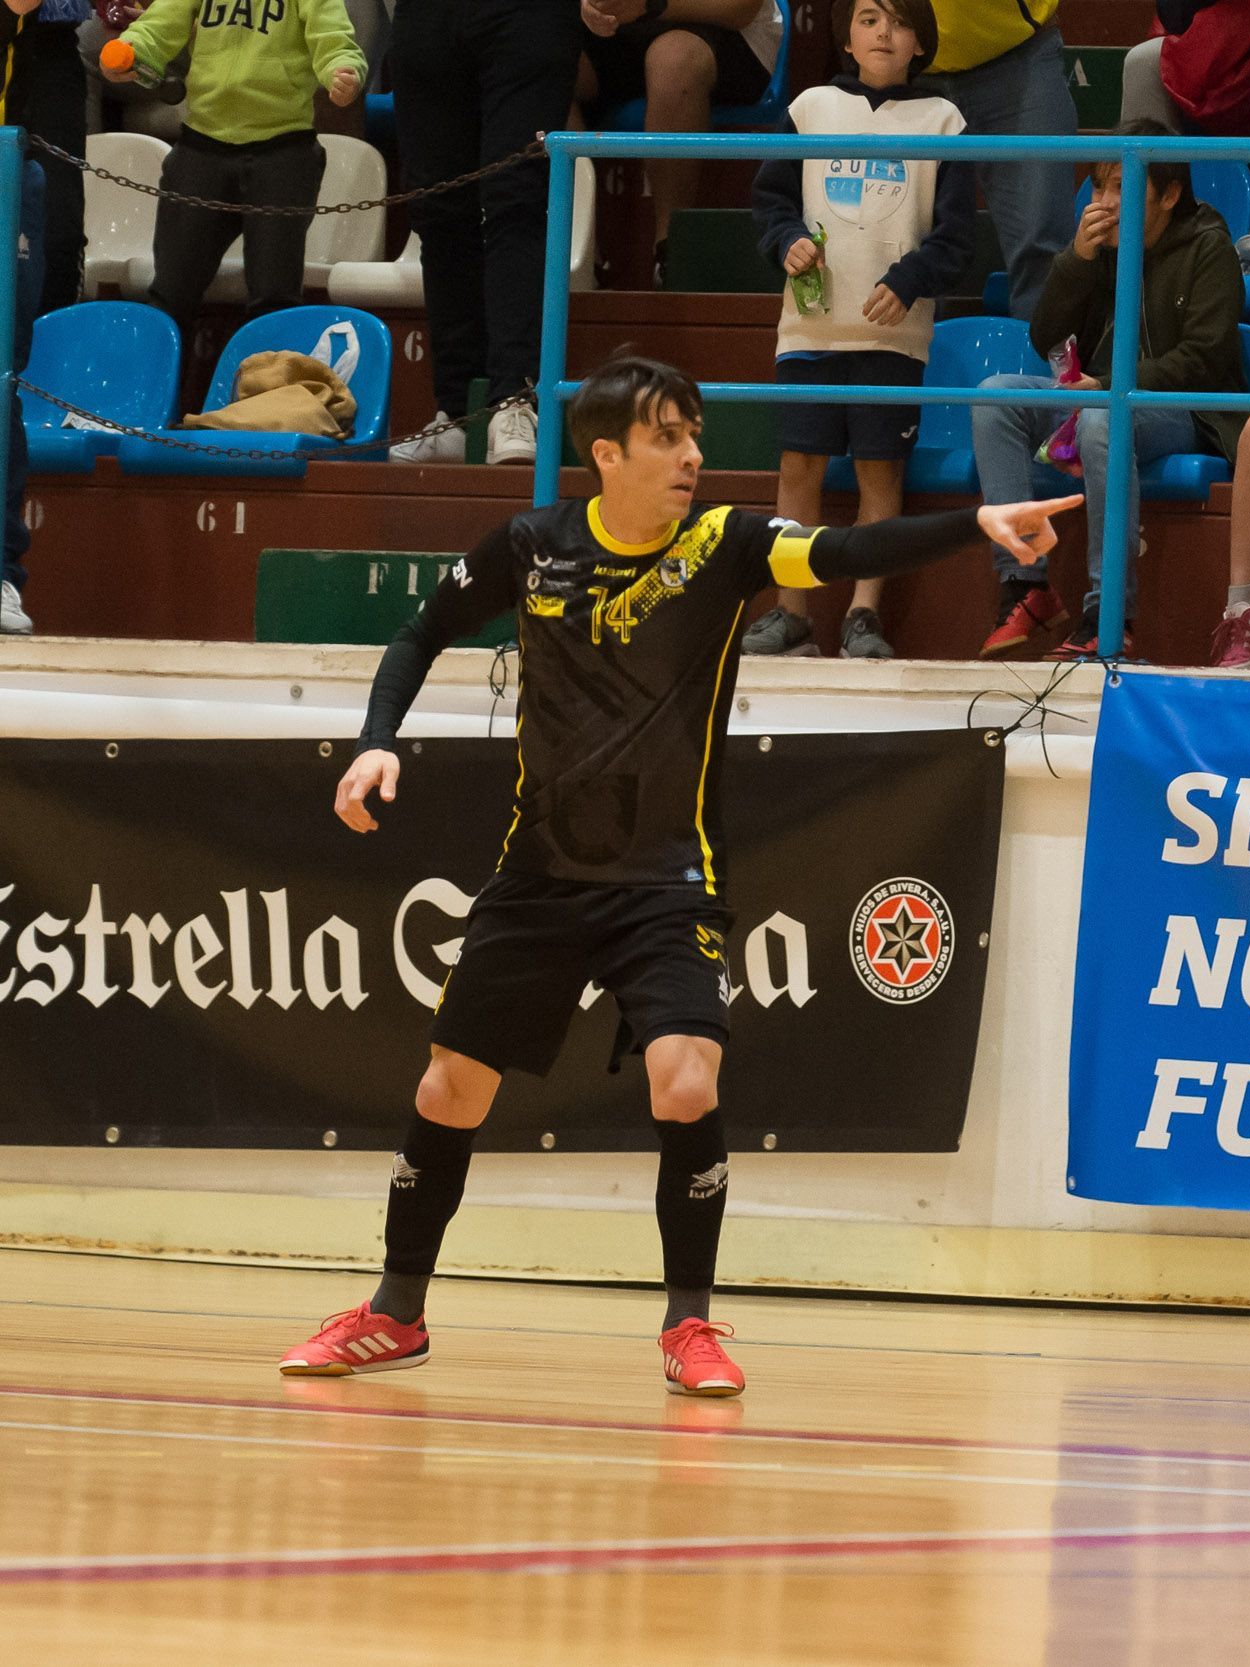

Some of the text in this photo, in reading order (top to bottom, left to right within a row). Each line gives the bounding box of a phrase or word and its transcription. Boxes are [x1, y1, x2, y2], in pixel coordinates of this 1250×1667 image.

[200, 0, 285, 35] GAP
[829, 181, 902, 197] SILVER
[196, 501, 246, 534] 61
[587, 586, 639, 645] 14
[855, 899, 876, 933] HIJOS
[873, 887, 889, 900] DE
[855, 944, 950, 999] CERVECEROS DESDE 1906
